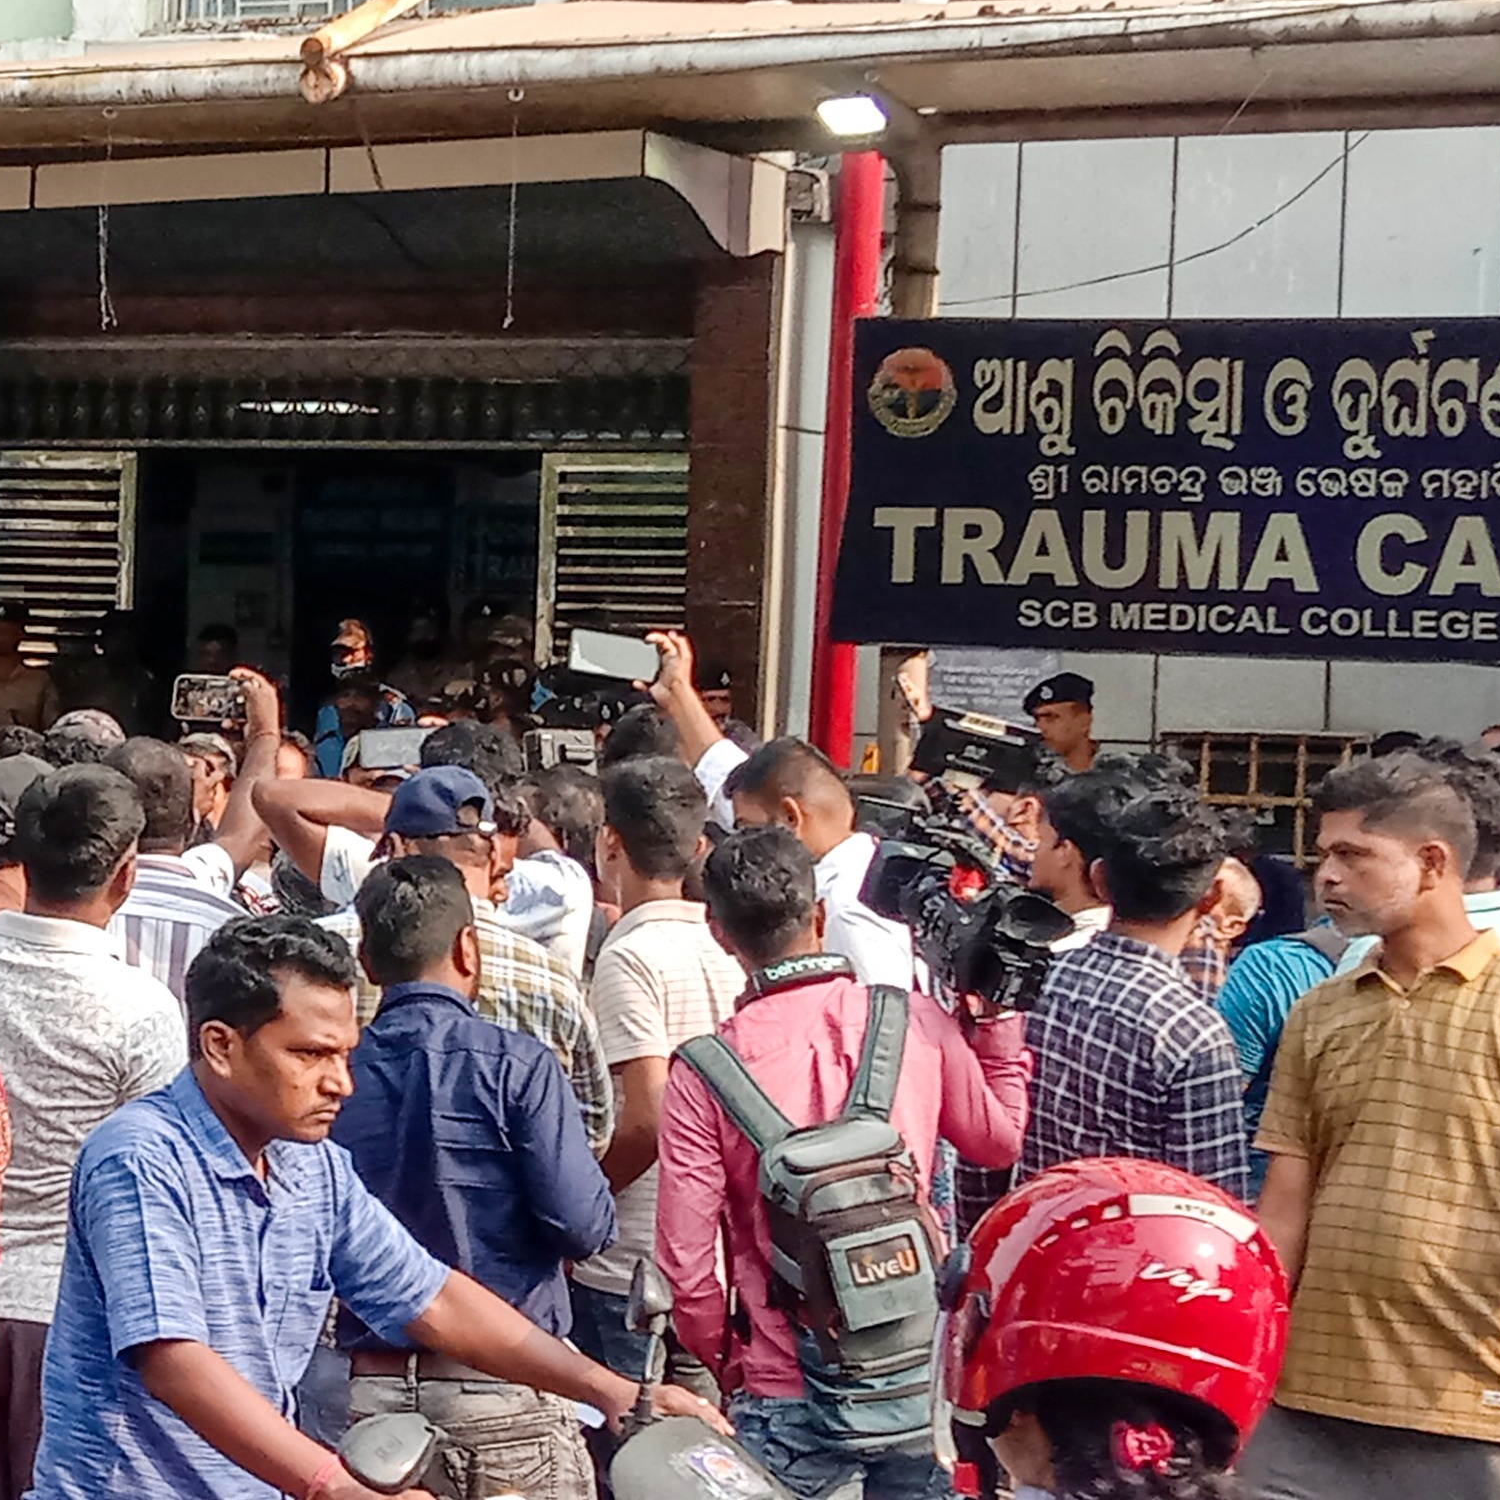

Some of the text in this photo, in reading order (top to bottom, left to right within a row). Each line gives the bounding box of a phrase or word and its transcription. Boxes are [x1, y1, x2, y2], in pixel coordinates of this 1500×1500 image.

[971, 357, 1076, 457] ଆଶୁ
[1092, 327, 1244, 451] ଚିକିତ୍ସା
[1263, 357, 1315, 437] ଓ
[1027, 463, 1069, 500] ଶ୍ରୀ
[874, 505, 1321, 595] TRAUMA
[1018, 599, 1100, 631] SCB
[1109, 602, 1290, 637] MEDICAL
[1300, 607, 1499, 642] COLLEGE
